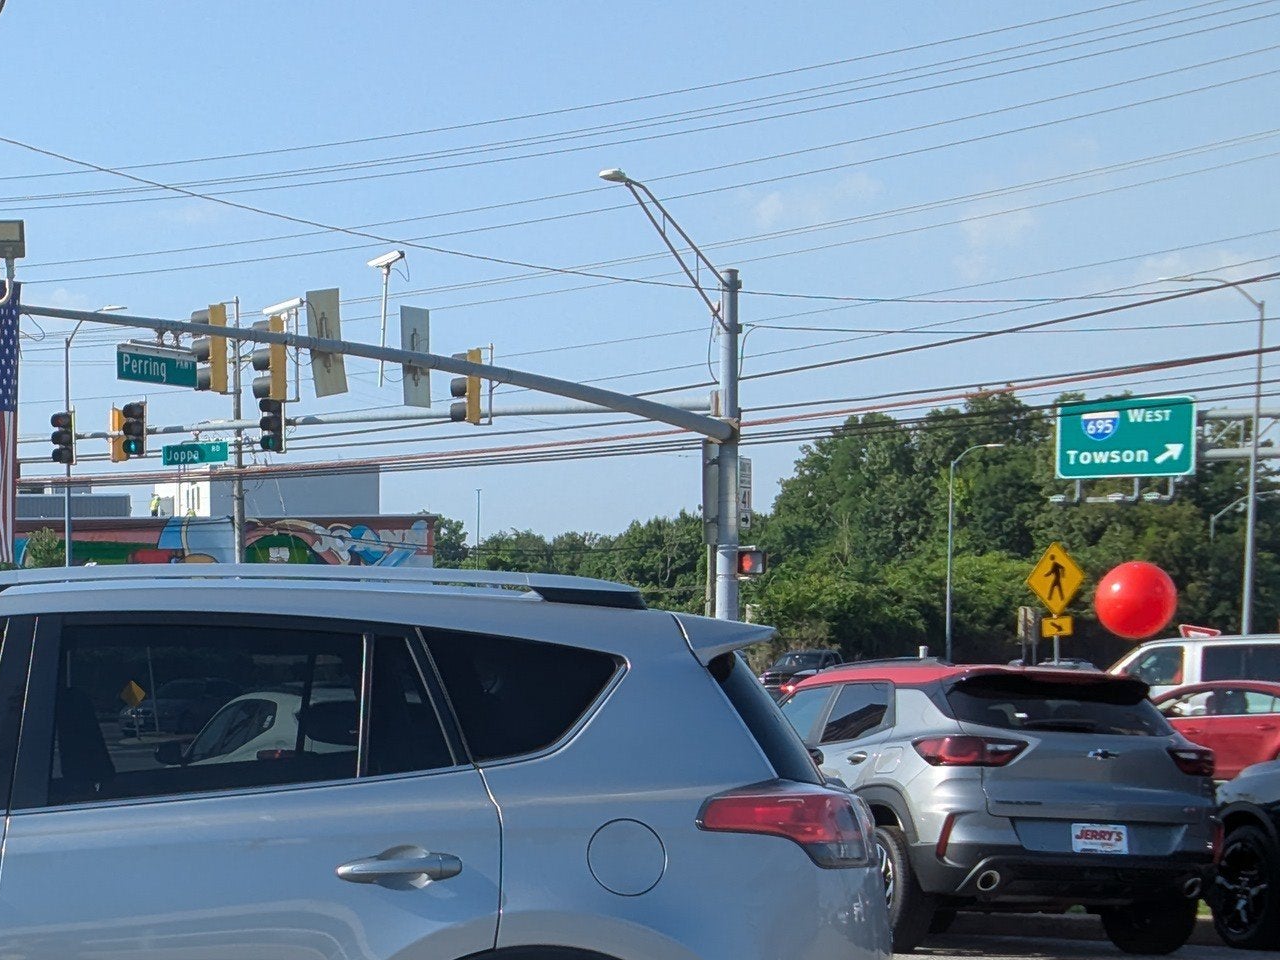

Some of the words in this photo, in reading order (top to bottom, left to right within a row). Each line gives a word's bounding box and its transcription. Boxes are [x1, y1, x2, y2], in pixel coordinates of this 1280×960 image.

[122, 353, 167, 383] Perring
[1086, 418, 1114, 435] 695
[167, 449, 199, 464] Joppa
[1075, 829, 1123, 842] JERRY'S
